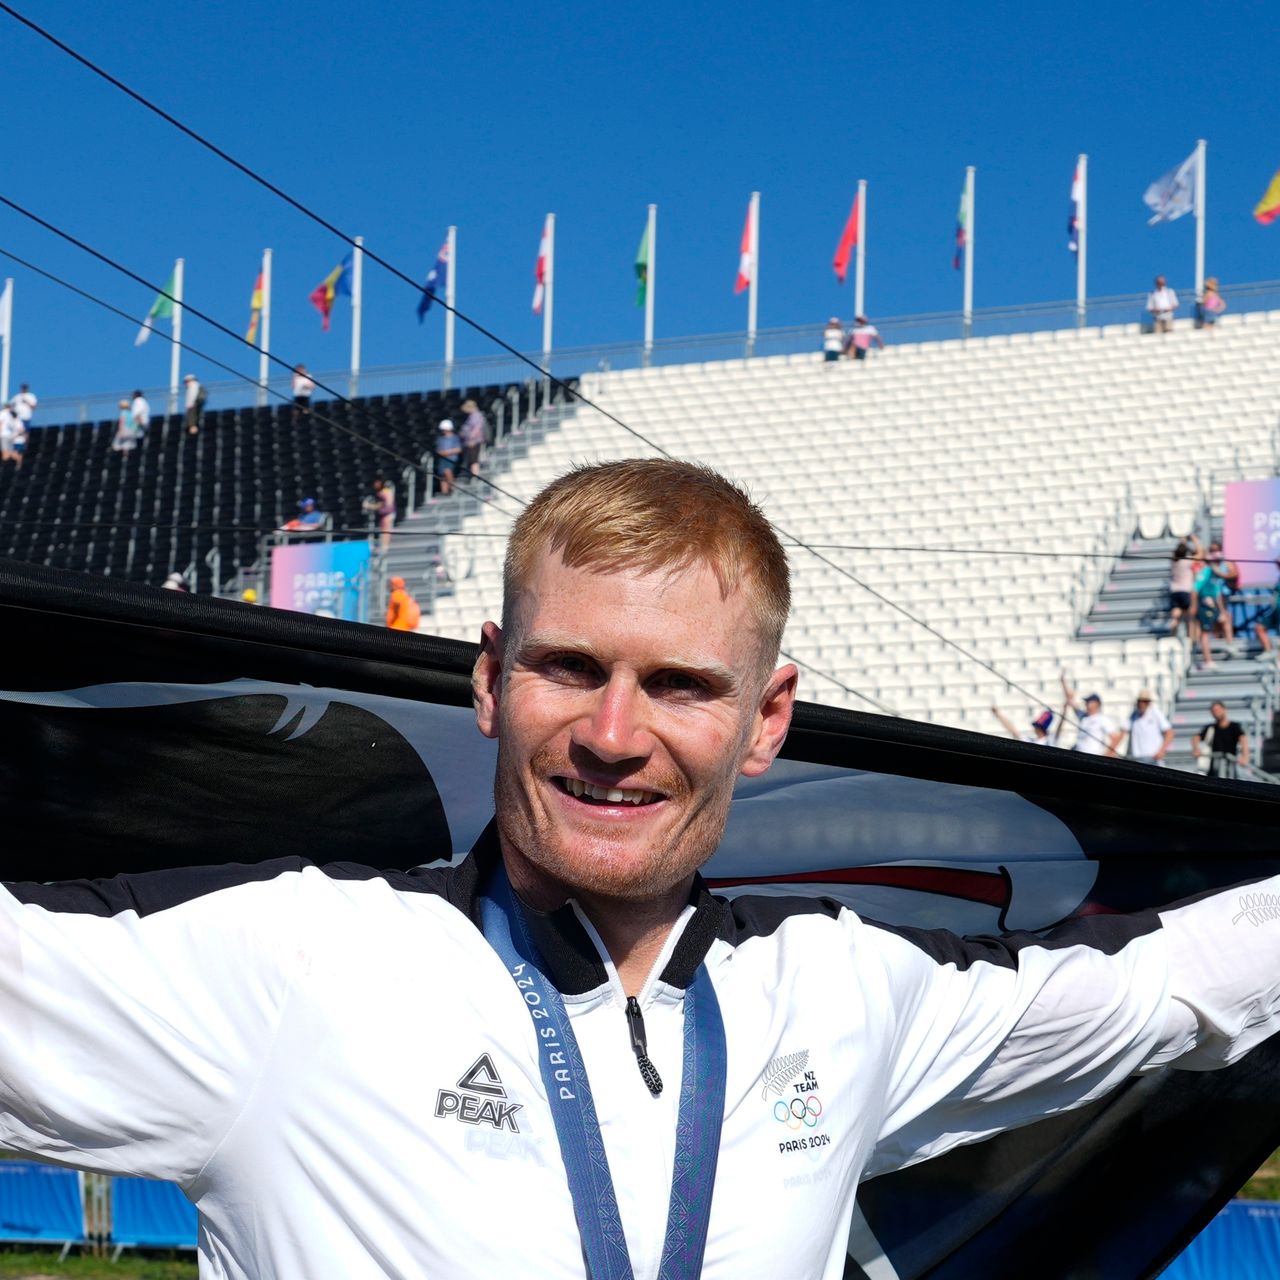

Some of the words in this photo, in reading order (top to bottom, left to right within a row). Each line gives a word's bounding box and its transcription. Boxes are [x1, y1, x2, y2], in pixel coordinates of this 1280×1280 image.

[513, 963, 549, 1019] 2024
[540, 1027, 576, 1100] PARIS
[803, 1070, 817, 1081] NZ
[793, 1081, 819, 1094] TEAM
[434, 1088, 524, 1134] PEAK
[779, 1138, 808, 1154] PARIS
[808, 1134, 831, 1149] 2024
